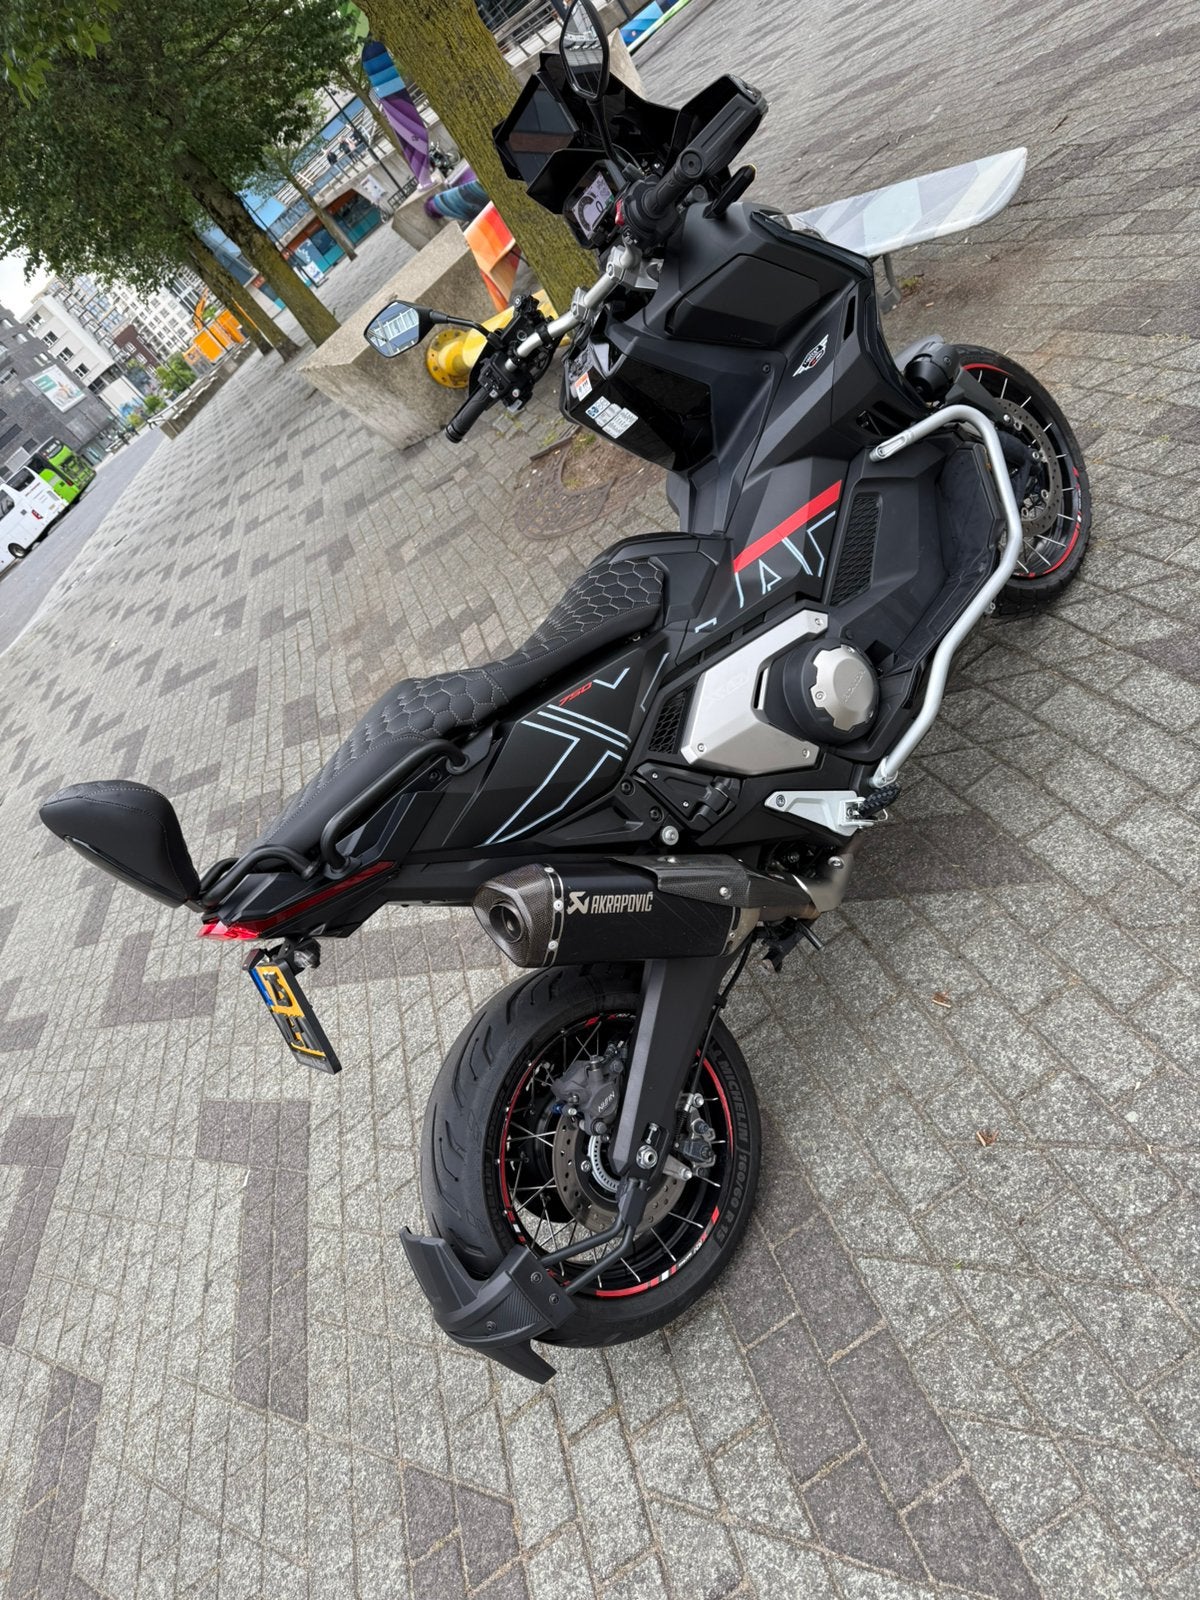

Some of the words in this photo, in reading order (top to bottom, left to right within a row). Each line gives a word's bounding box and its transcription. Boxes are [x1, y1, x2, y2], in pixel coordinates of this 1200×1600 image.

[559, 682, 593, 706] 750
[718, 1061, 748, 1142] MICHELIN
[731, 1154, 747, 1208] 160/60
